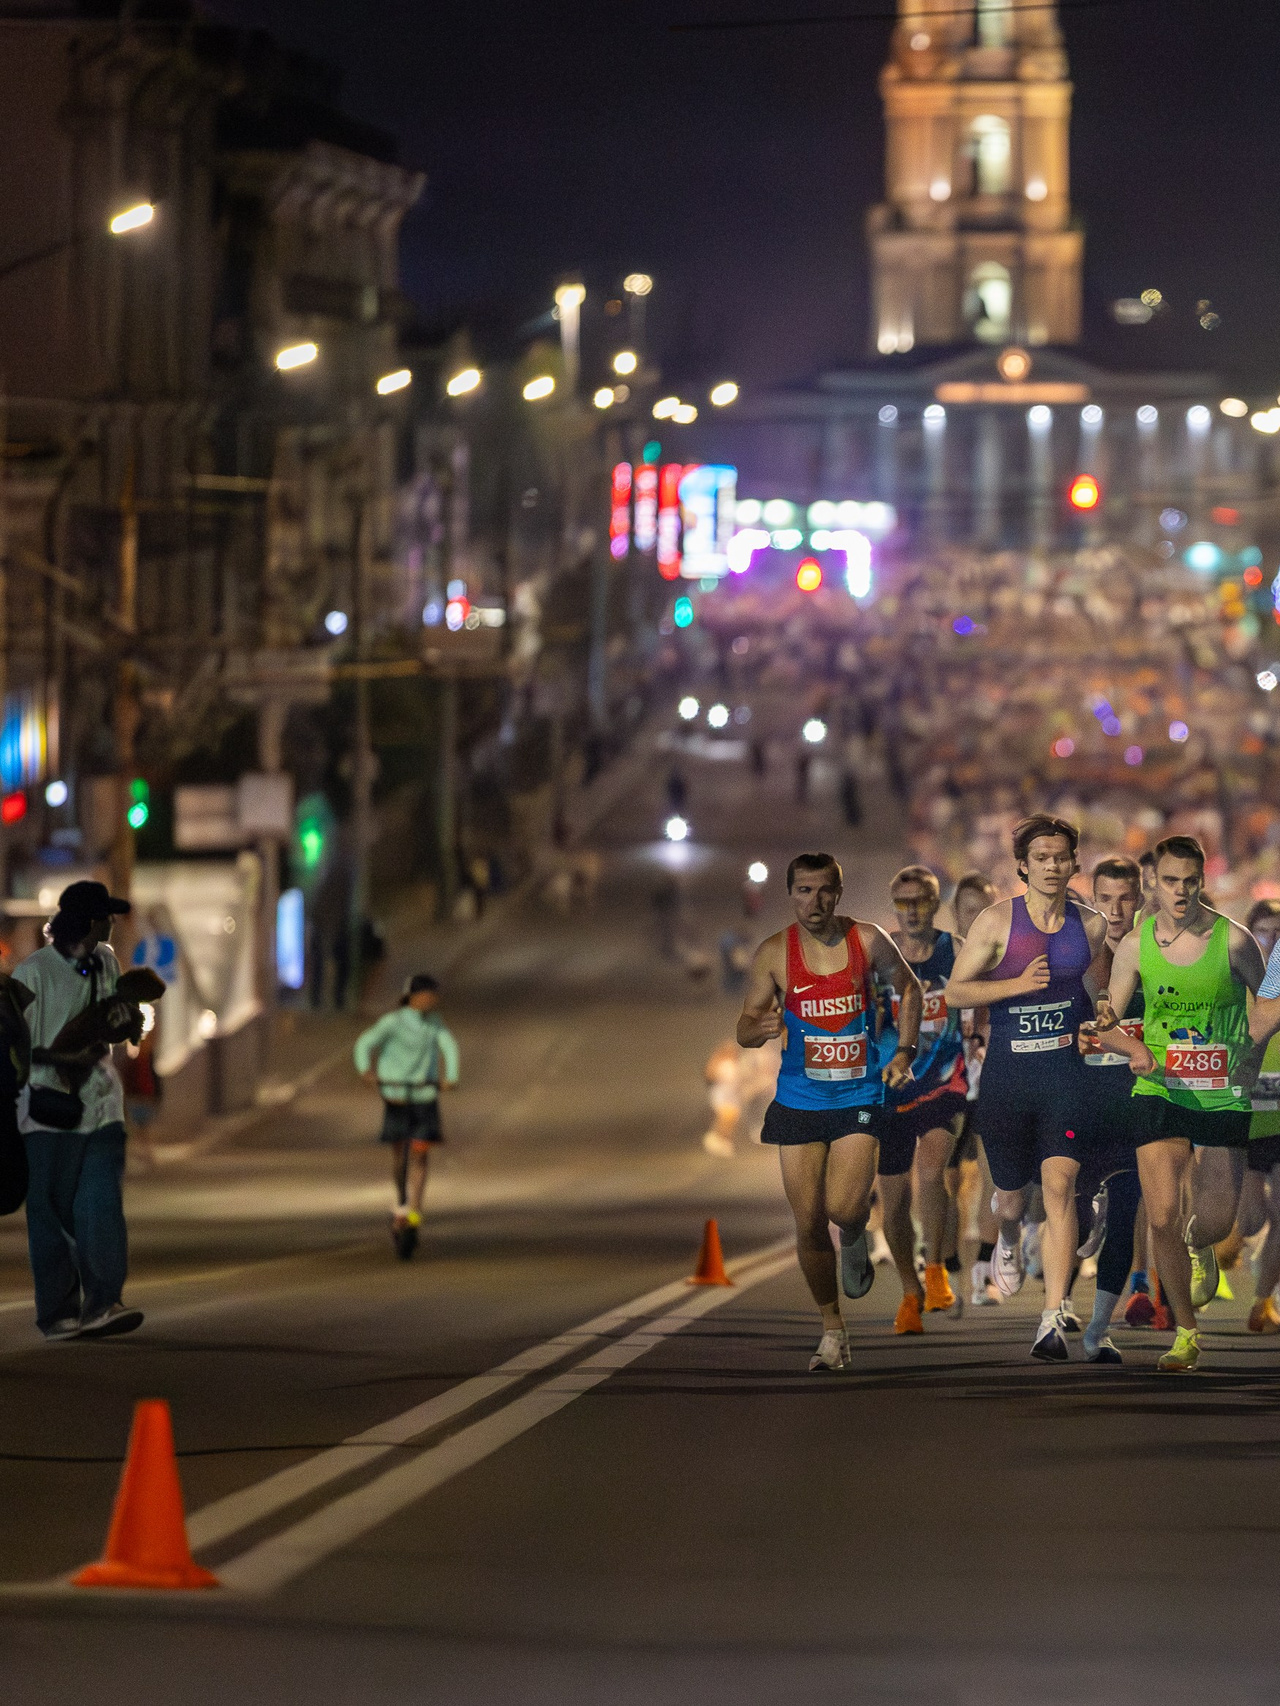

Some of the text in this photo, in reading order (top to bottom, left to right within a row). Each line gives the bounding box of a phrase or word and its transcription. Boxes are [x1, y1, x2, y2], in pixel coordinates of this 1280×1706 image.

[800, 994, 863, 1017] RUSSIA
[1019, 1011, 1065, 1033] 5142
[811, 1042, 861, 1063] 2909
[1171, 1052, 1222, 1071] 2486
